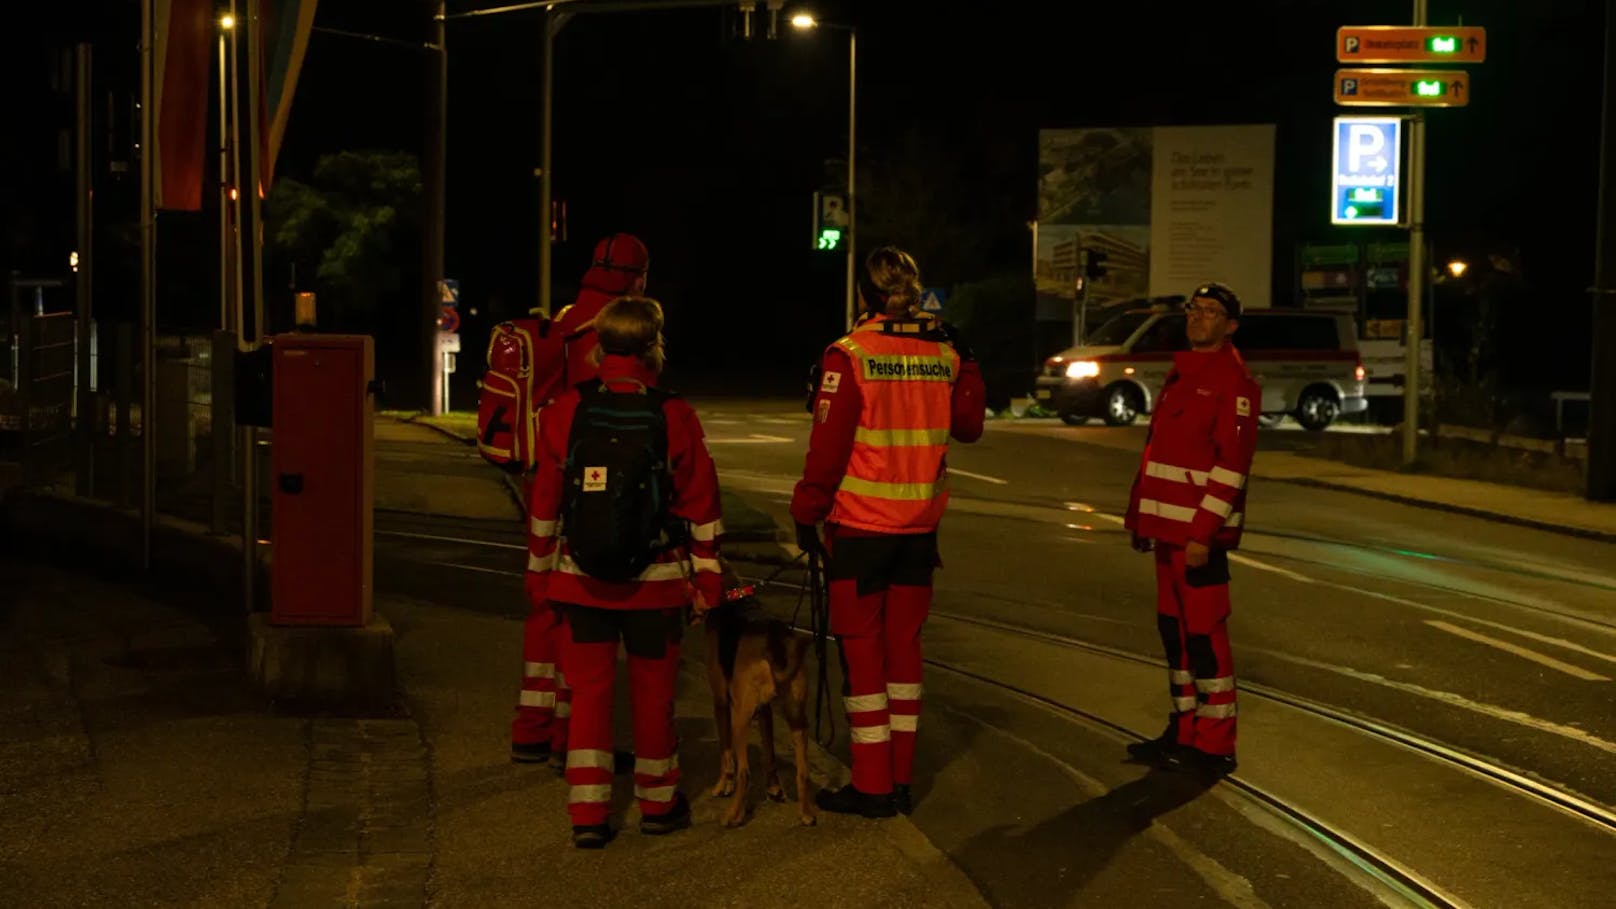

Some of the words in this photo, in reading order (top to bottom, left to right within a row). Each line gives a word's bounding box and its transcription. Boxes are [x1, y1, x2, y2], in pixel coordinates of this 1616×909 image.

[1345, 38, 1357, 51] P
[1344, 80, 1355, 94] P
[1348, 124, 1385, 172] P
[868, 359, 951, 377] Personensuche
